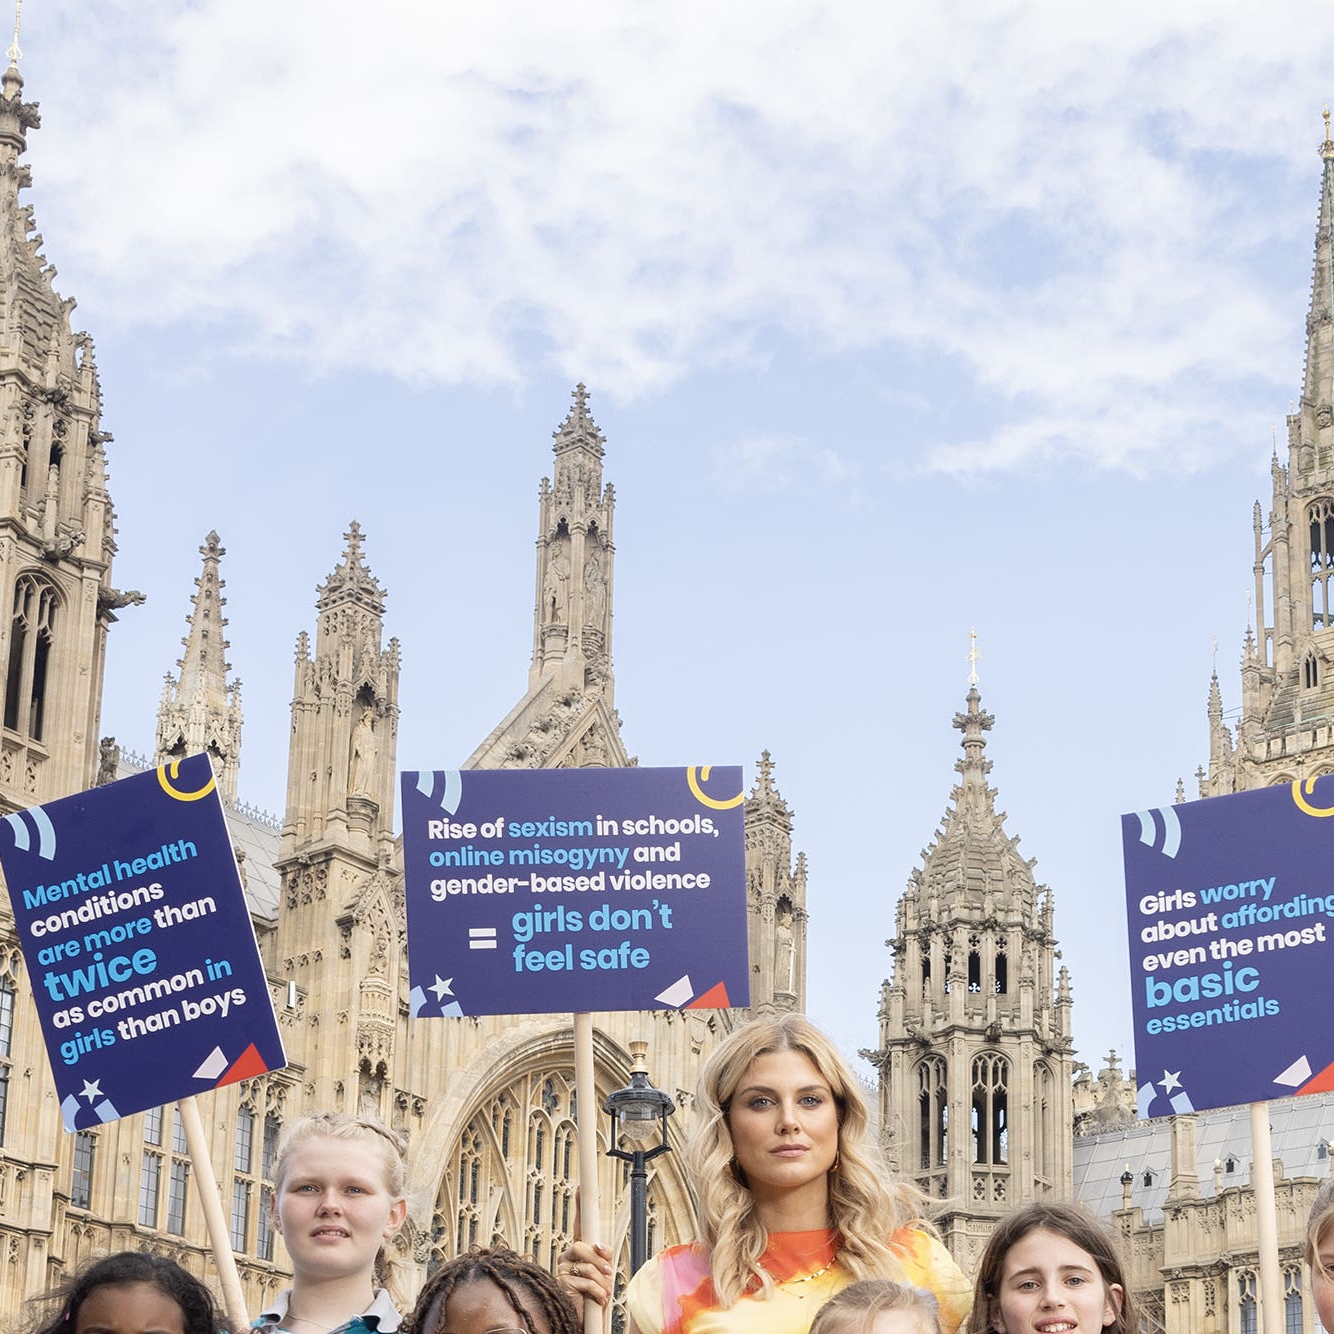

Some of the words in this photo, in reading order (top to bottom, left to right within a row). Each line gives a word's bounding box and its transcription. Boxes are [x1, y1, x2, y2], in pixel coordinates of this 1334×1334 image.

[427, 818, 477, 840] Rise
[480, 817, 504, 839] of
[508, 816, 593, 838] sexism
[596, 815, 618, 836] in
[622, 814, 719, 838] schools,
[22, 862, 112, 910] Mental
[115, 839, 198, 881] health
[429, 844, 504, 868] online
[509, 843, 629, 870] misogyny
[633, 841, 681, 863] and
[430, 871, 605, 902] gender-based
[609, 869, 711, 891] violence
[1139, 889, 1197, 916] Girls
[1200, 876, 1277, 906] worry
[29, 881, 165, 938] conditions
[512, 903, 583, 942] girls
[588, 900, 673, 932] don't
[1140, 911, 1218, 943] about
[37, 939, 80, 966] are
[83, 916, 152, 952] more
[153, 896, 217, 929] than
[468, 928, 497, 949] =
[1142, 944, 1207, 972] even
[1209, 937, 1253, 960] the
[1257, 922, 1325, 953] most
[43, 947, 158, 1002] twice
[513, 944, 573, 972] feel
[580, 941, 651, 970] safe
[52, 1003, 84, 1029] as
[86, 968, 205, 1019] common
[203, 958, 233, 981] in
[1145, 960, 1259, 1009] basic
[59, 1026, 116, 1066] girls
[117, 1009, 180, 1041] than
[182, 986, 246, 1023] boys
[1146, 996, 1280, 1035] essentials
